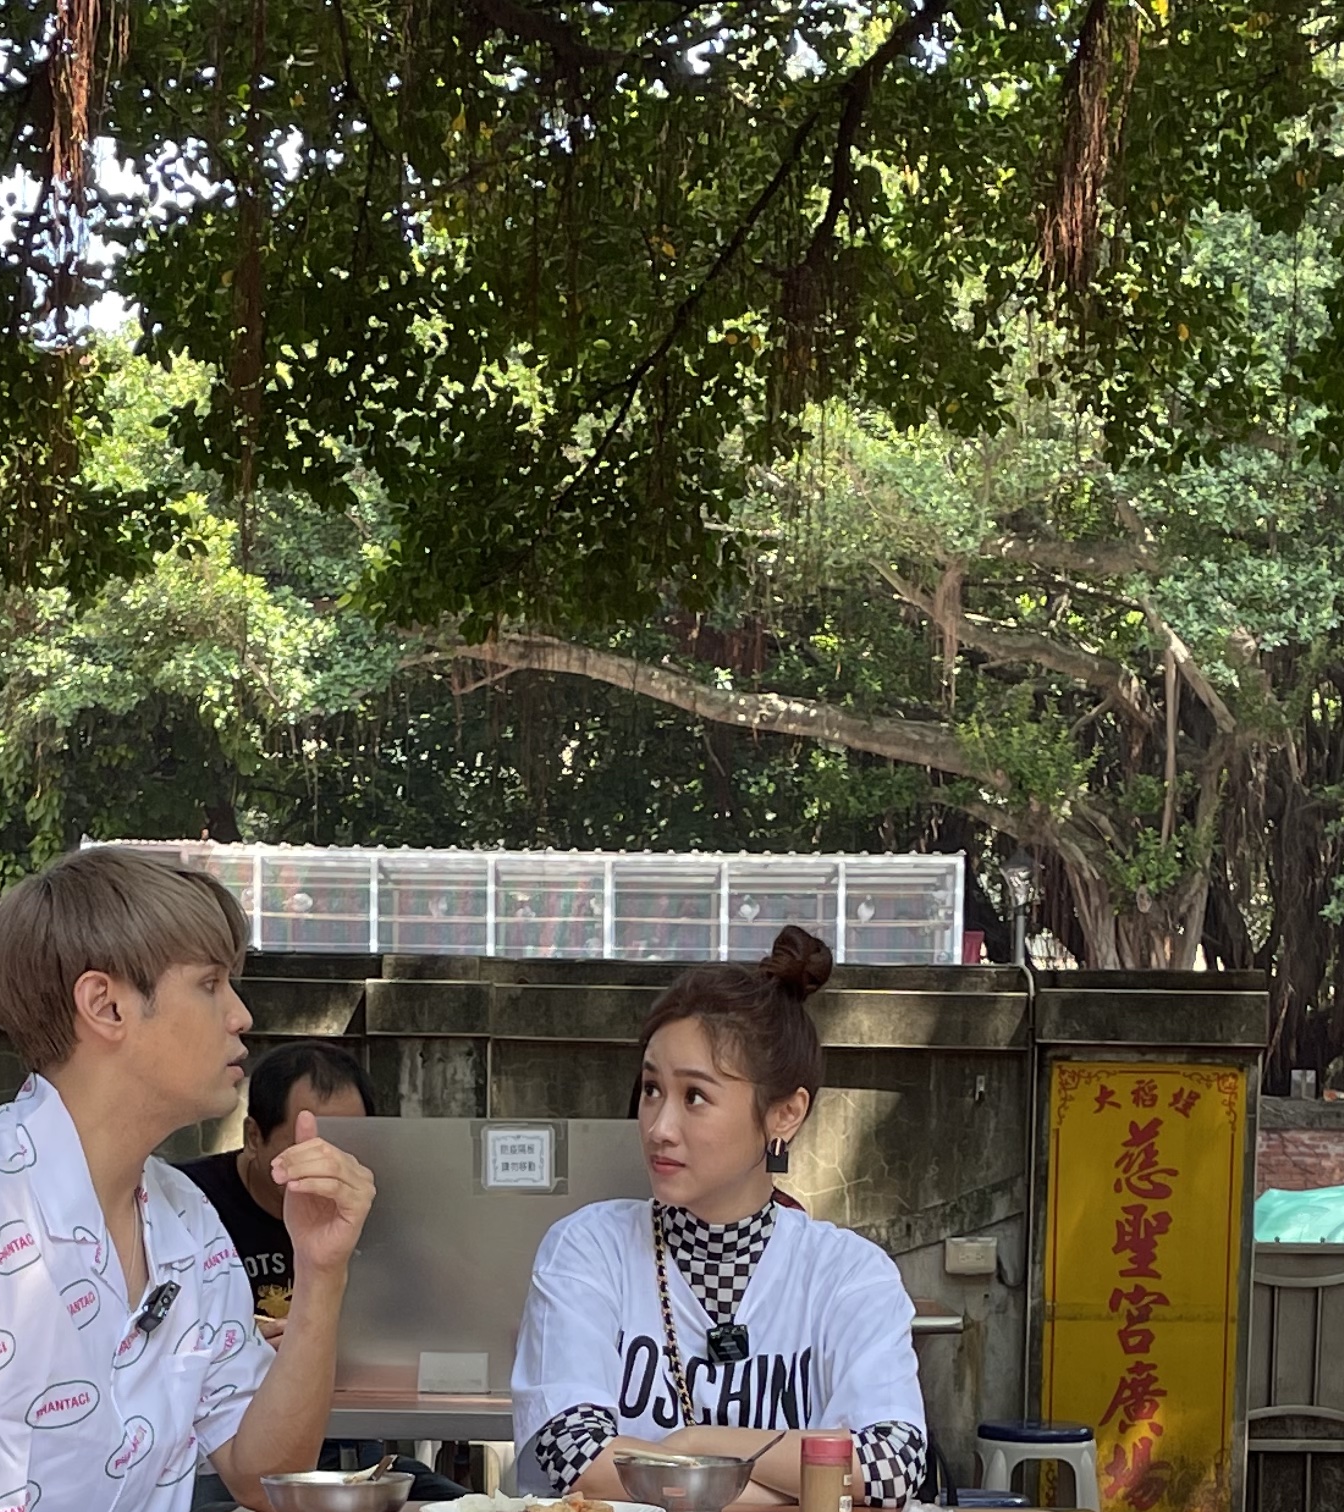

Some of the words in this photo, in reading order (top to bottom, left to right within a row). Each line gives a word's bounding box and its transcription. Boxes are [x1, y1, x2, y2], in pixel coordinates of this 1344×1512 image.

[1093, 1079, 1201, 1119] 大稻埕
[1098, 1117, 1179, 1512] 慈聖宮廣場
[617, 1329, 812, 1430] OSCHIN
